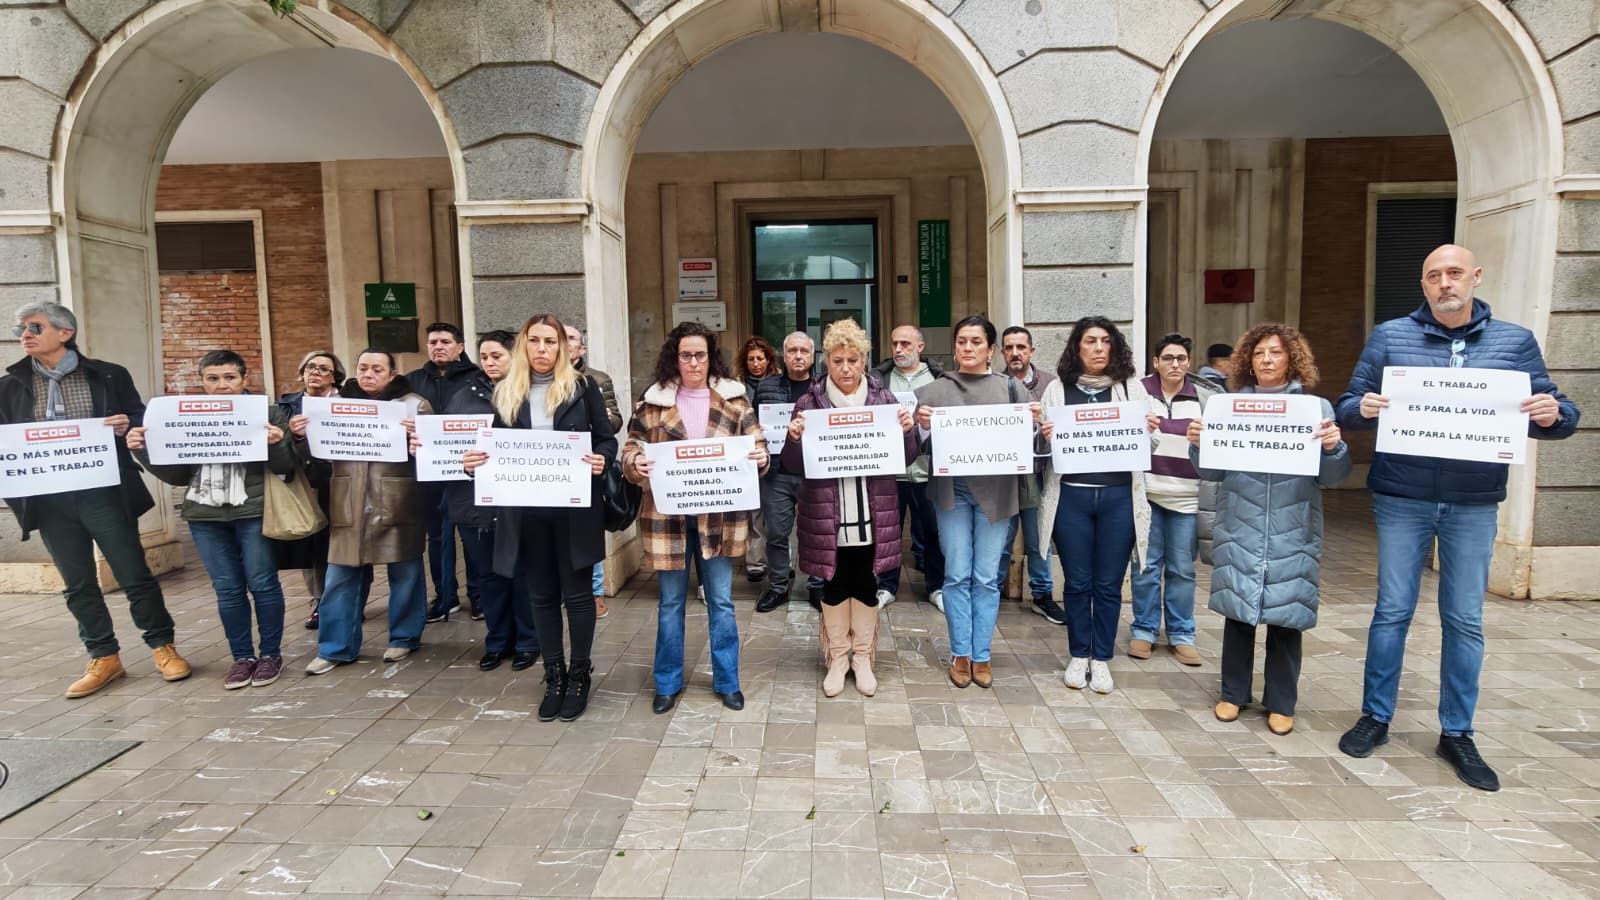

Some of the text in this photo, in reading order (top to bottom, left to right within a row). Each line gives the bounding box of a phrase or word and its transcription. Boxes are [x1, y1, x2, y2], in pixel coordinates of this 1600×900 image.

[922, 274, 930, 295] JUNTA
[1440, 381, 1487, 390] TRABAJO
[940, 420, 952, 428] LA
[1096, 428, 1143, 437] MUERTES
[1256, 425, 1313, 433] MUERTES
[818, 433, 861, 441] SEGURIDAD
[1466, 434, 1511, 444] MUERTE
[166, 440, 252, 448] RESPONSABILIDAD
[514, 442, 544, 450] MIRES
[1092, 444, 1138, 452] TRABAJO
[1249, 441, 1305, 450] TRABAJO
[54, 444, 108, 456] MUERTES
[498, 457, 526, 466] OTRO
[818, 452, 888, 462] RESPONSABILIDAD
[949, 452, 1018, 464] SALVA VIDAS
[6, 468, 27, 477] EN
[50, 460, 104, 472] TRABAJO
[666, 467, 712, 476] SEGURIDAD
[828, 464, 880, 472] EMPRESARIAL
[666, 488, 742, 498] RESPONSABILIDAD
[677, 499, 734, 508] EMPRESARIAL
